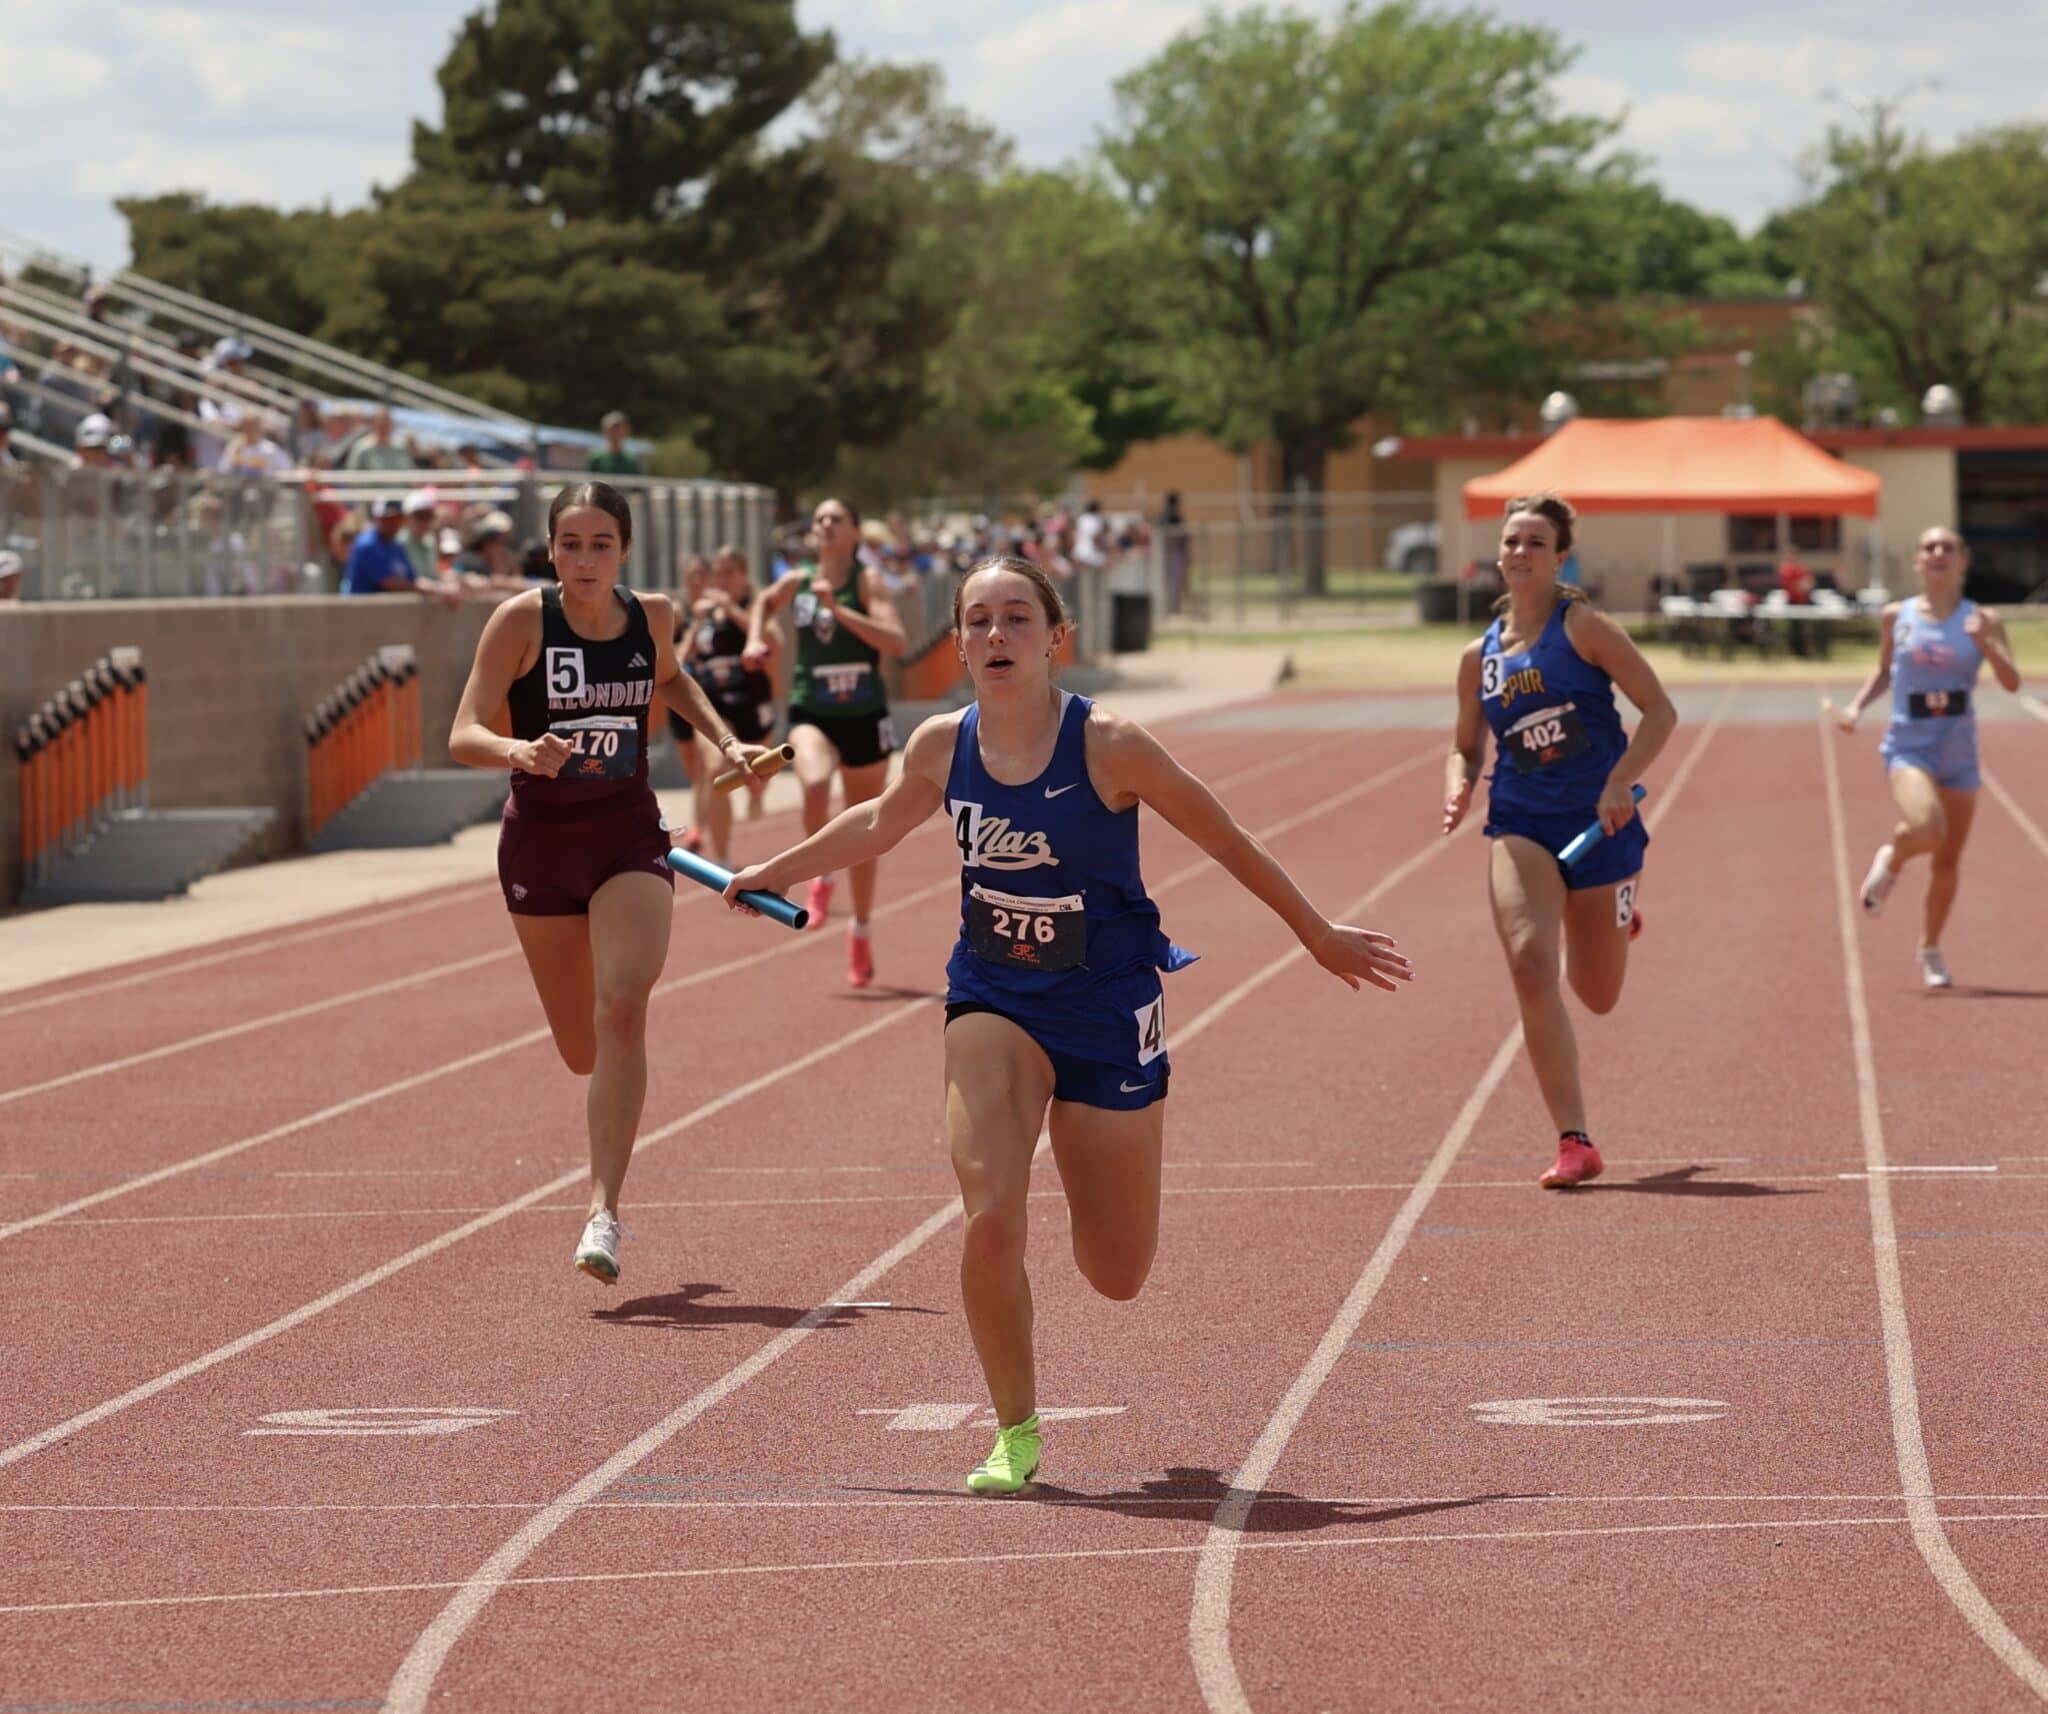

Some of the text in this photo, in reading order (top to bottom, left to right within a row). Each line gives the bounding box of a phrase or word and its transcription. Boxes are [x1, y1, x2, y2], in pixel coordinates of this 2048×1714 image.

[552, 651, 578, 695] 5
[1484, 658, 1498, 694] 3
[1500, 668, 1545, 709] SPUR
[570, 730, 619, 758] 170
[1522, 719, 1566, 751] 402
[956, 806, 973, 861] 4
[977, 816, 1059, 870] Naz
[1619, 885, 1633, 922] 3
[992, 908, 1055, 943] 276
[1143, 1004, 1162, 1053] 4
